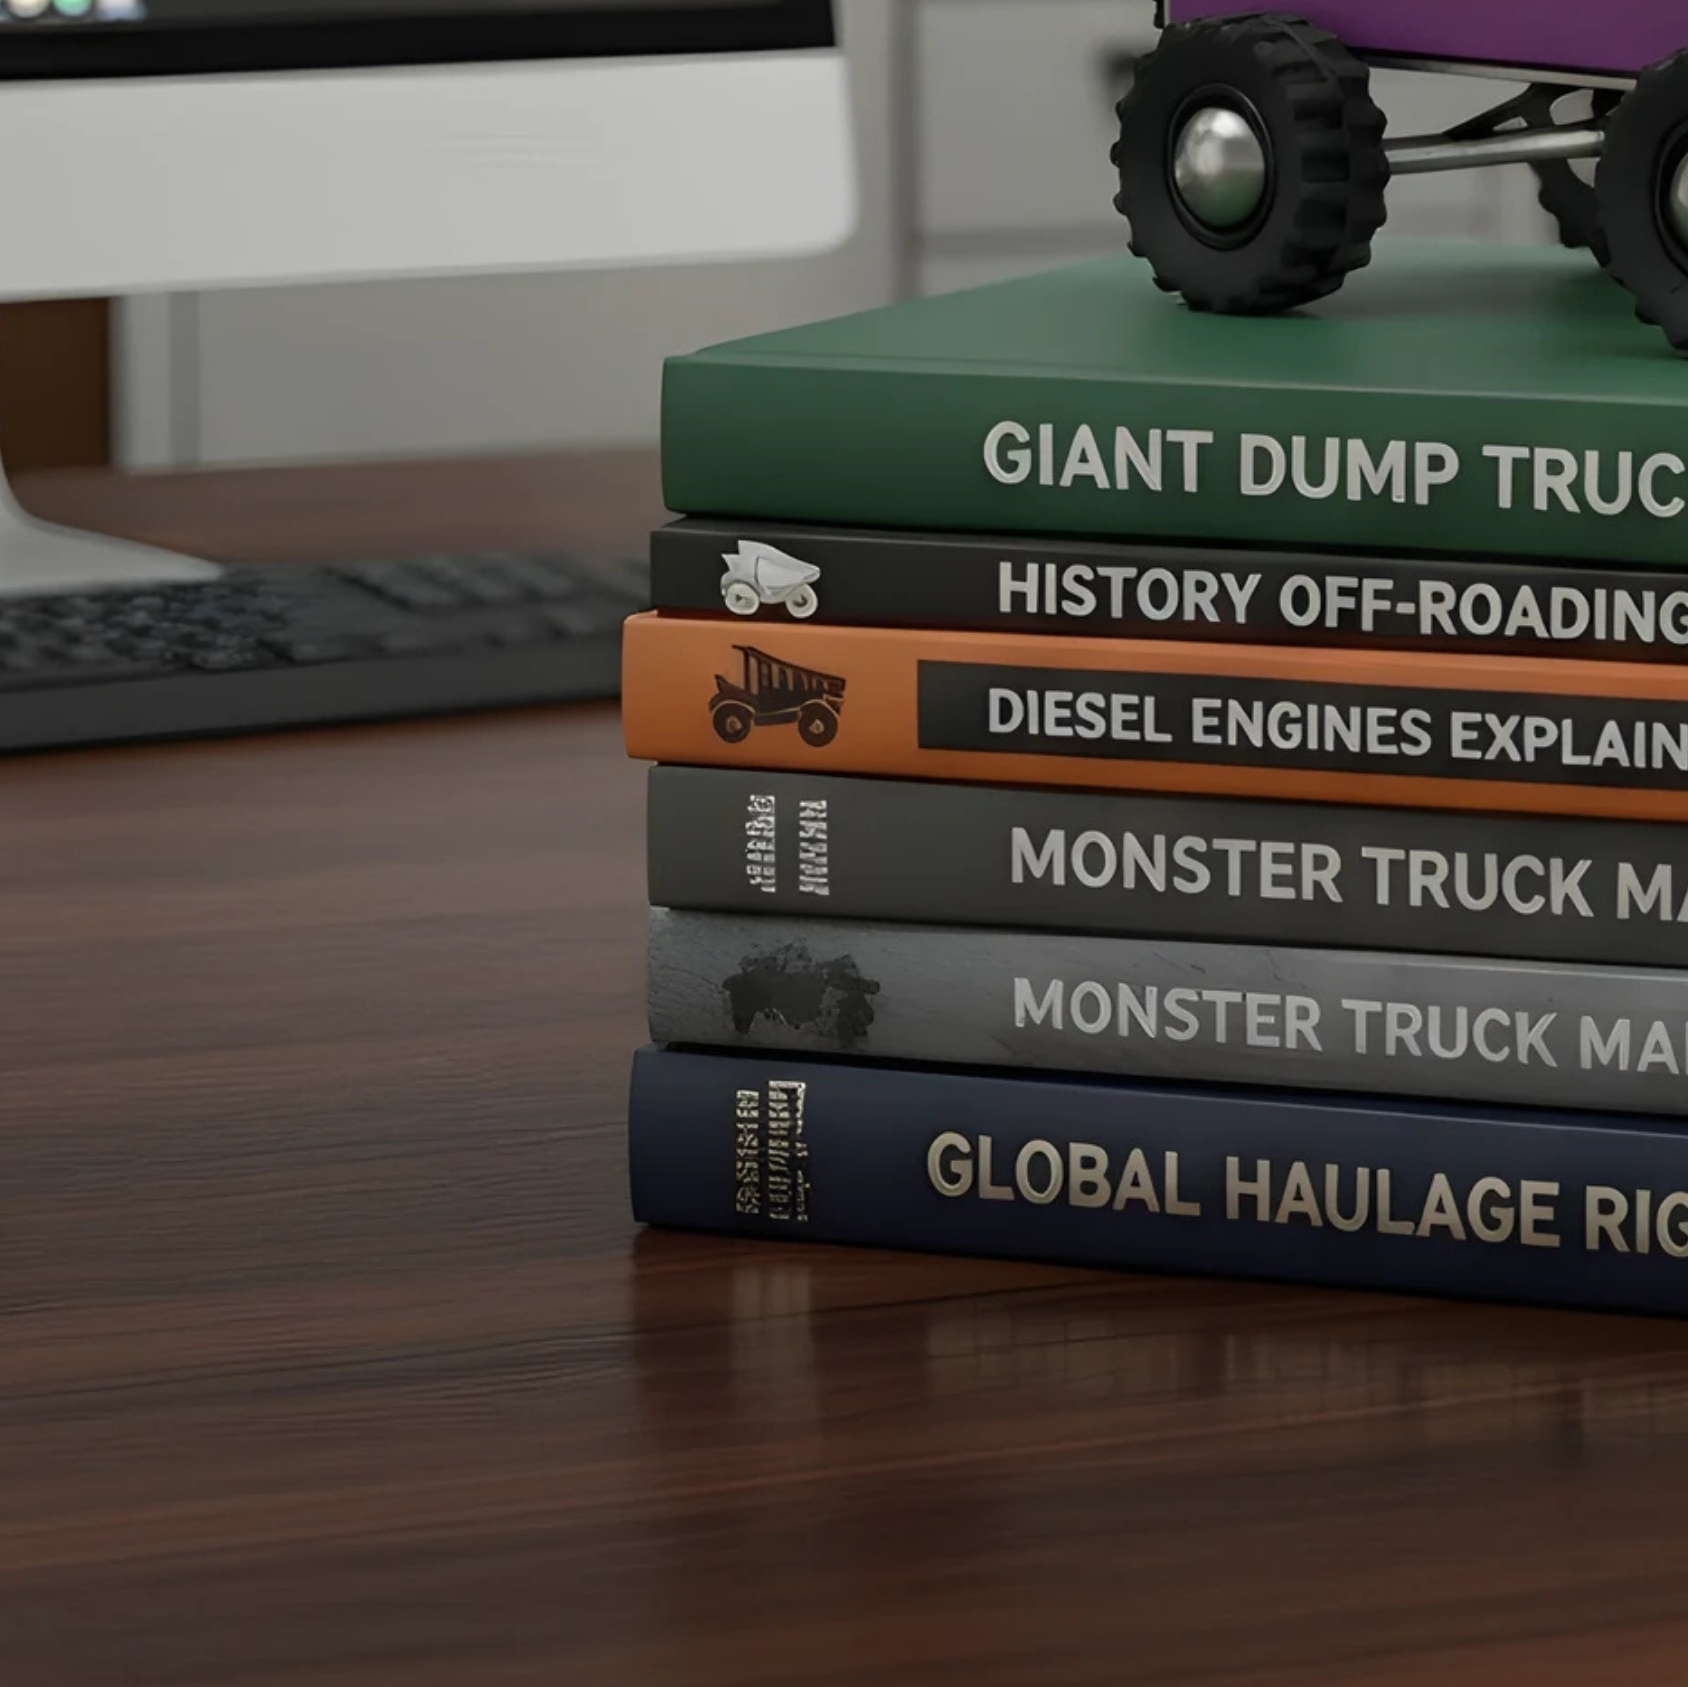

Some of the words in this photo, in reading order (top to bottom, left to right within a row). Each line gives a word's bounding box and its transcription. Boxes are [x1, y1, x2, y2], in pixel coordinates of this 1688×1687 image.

[982, 419, 1214, 494] GIANT
[1238, 433, 1460, 507] DUMP
[997, 561, 1262, 626] HISTORY
[987, 687, 1173, 745] DIESEL
[1190, 698, 1432, 758] ENGINES
[1009, 826, 1344, 905] MONSTER
[1361, 845, 1595, 918] TRUCK
[1013, 976, 1323, 1053] MONSTER
[1341, 997, 1559, 1070] TRUCK
[927, 1130, 1202, 1221] GLOBAL
[1224, 1154, 1562, 1250] HAULAGE
